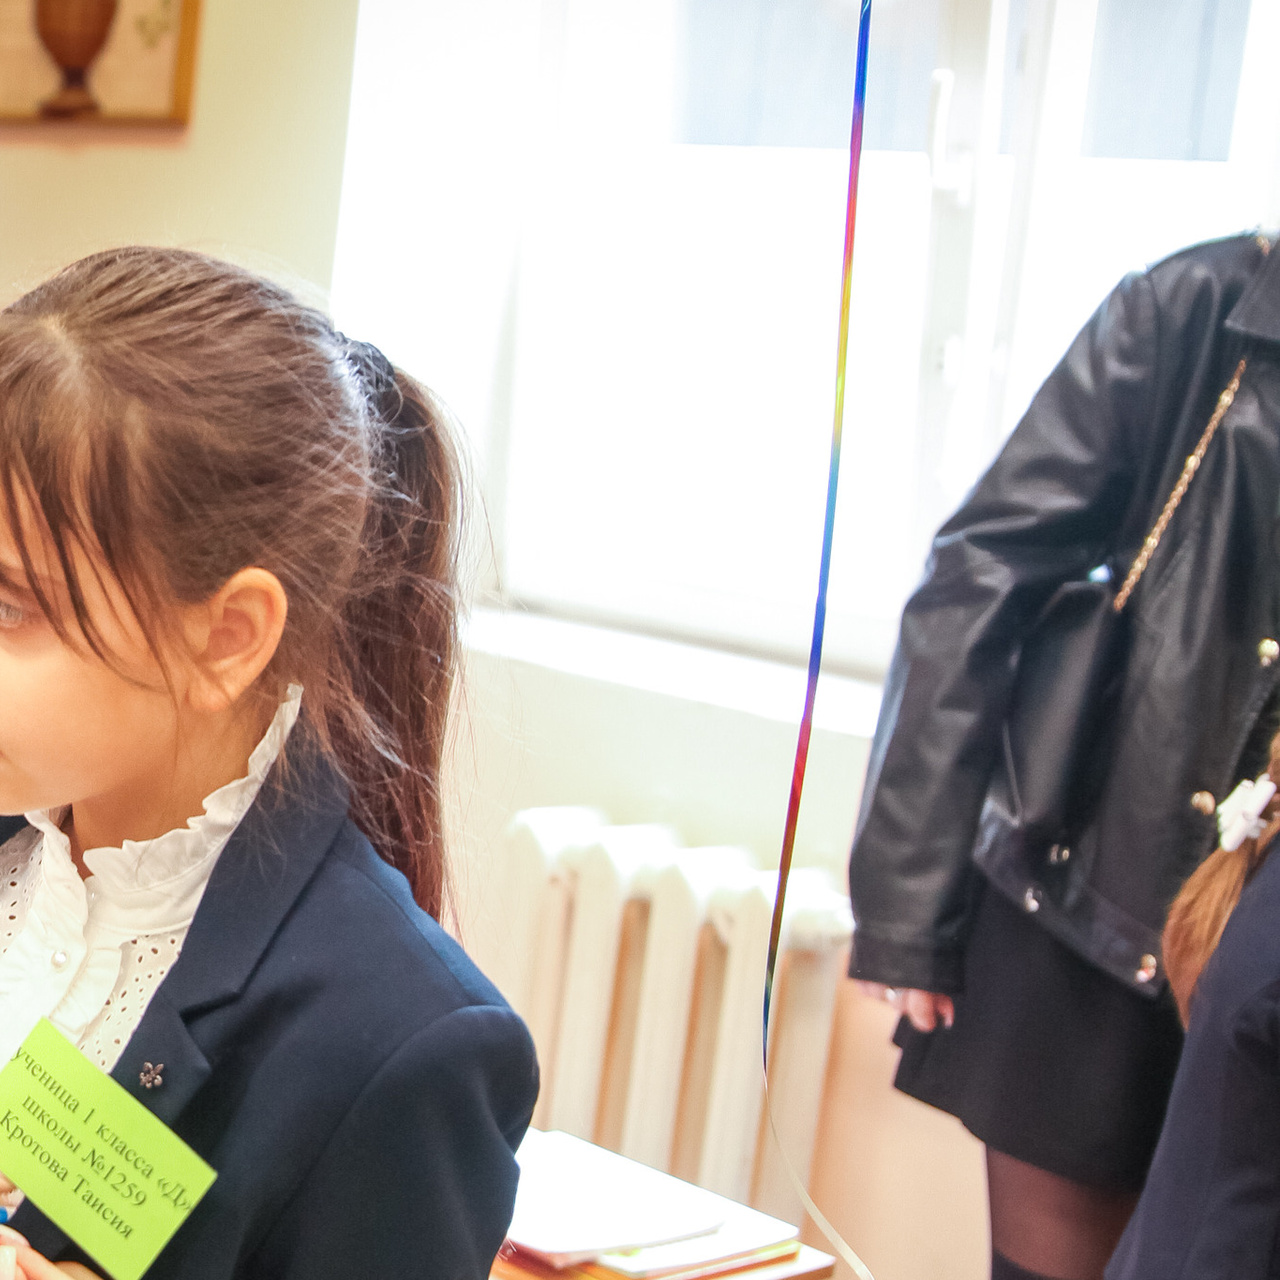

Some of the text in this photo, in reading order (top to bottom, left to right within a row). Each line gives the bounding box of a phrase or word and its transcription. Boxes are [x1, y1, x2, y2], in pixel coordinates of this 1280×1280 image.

[0, 1109, 134, 1238] Кротова Таисия
[10, 1046, 80, 1114] ученица
[82, 1108, 96, 1123] 1
[95, 1123, 153, 1178] класса
[21, 1095, 148, 1208] школы №1259
